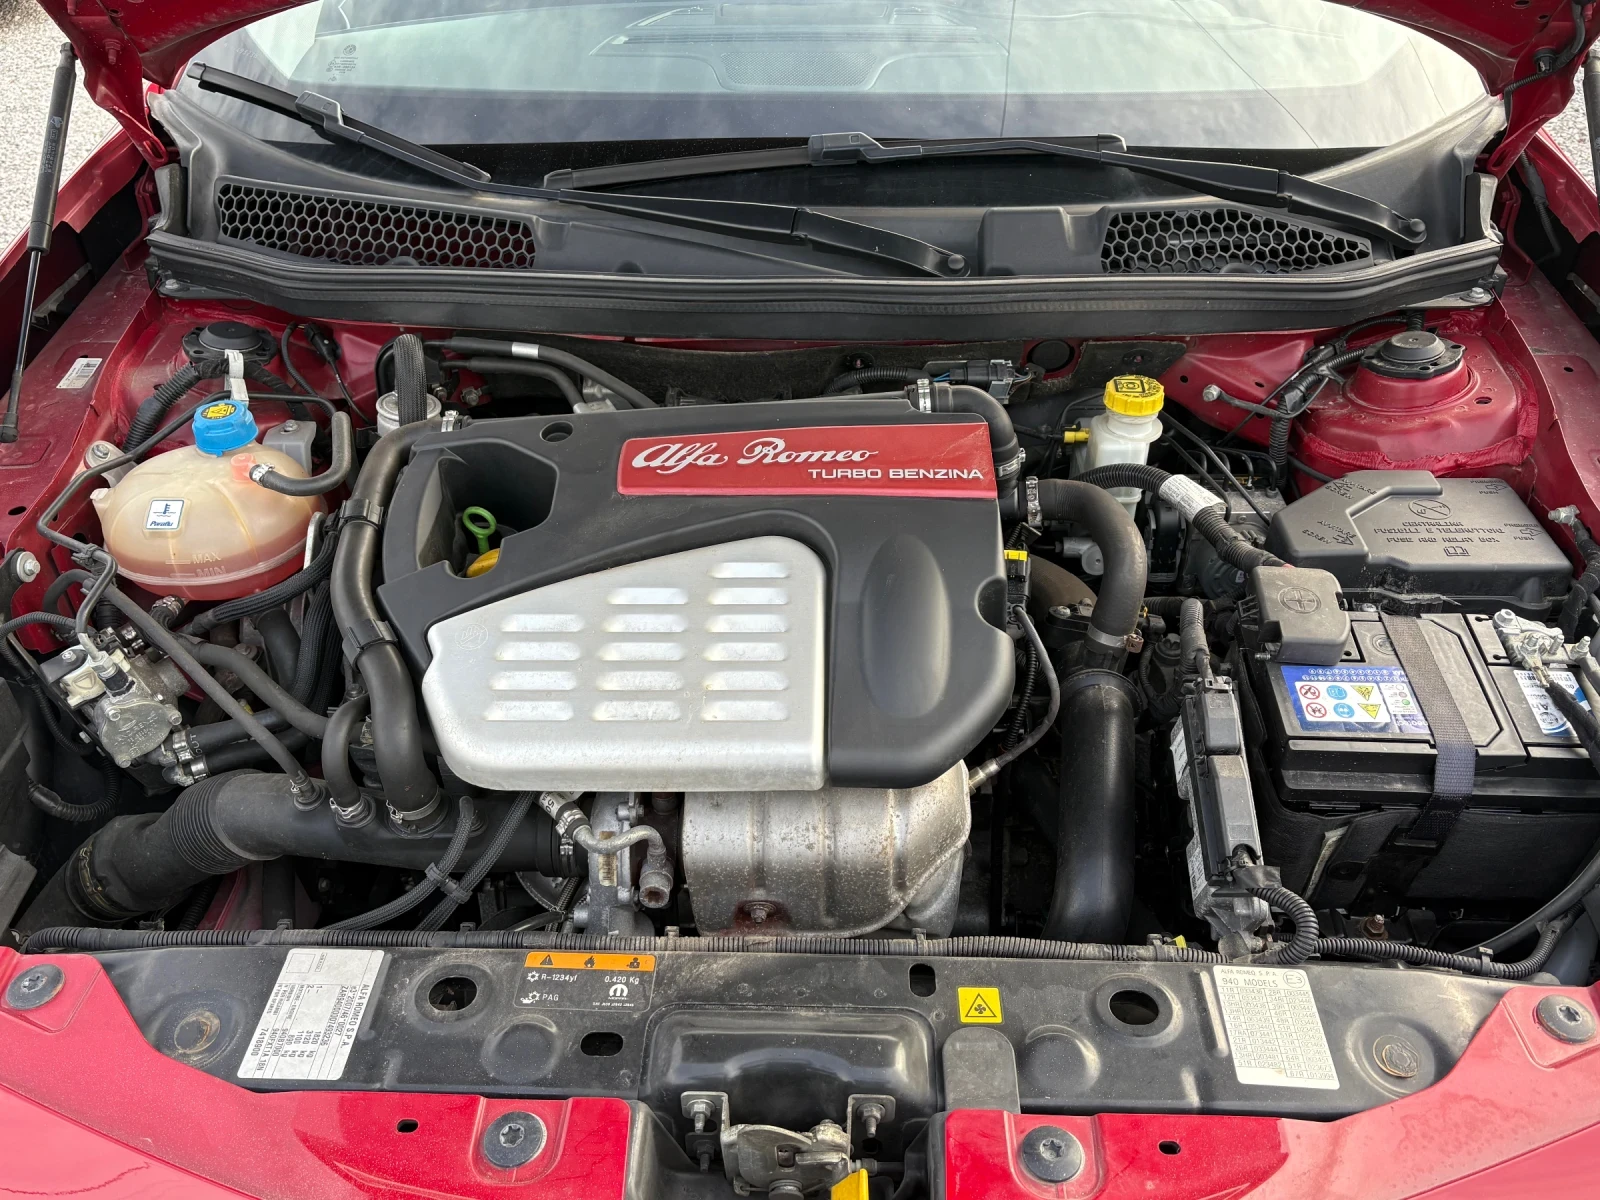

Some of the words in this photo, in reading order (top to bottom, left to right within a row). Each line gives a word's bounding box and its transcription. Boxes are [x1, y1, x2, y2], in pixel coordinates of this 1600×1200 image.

[631, 442, 728, 474] Alfa
[736, 438, 878, 465] Romeo
[808, 468, 882, 480] TURBO
[888, 468, 984, 480] BENZINA
[192, 552, 221, 564] MAX
[196, 566, 226, 578] MIN
[190, 733, 203, 754] OUT
[546, 800, 554, 814] 50
[541, 974, 578, 982] R-1234yf
[1243, 978, 1278, 987] MODELS
[1285, 974, 1303, 984] E3
[357, 984, 370, 1000] ALFA
[348, 1002, 363, 1025] ROMEO
[250, 1028, 268, 1056] 7418900
[293, 1030, 304, 1044] 1100
[301, 1030, 313, 1044] 3120
[310, 1031, 321, 1044] 1820
